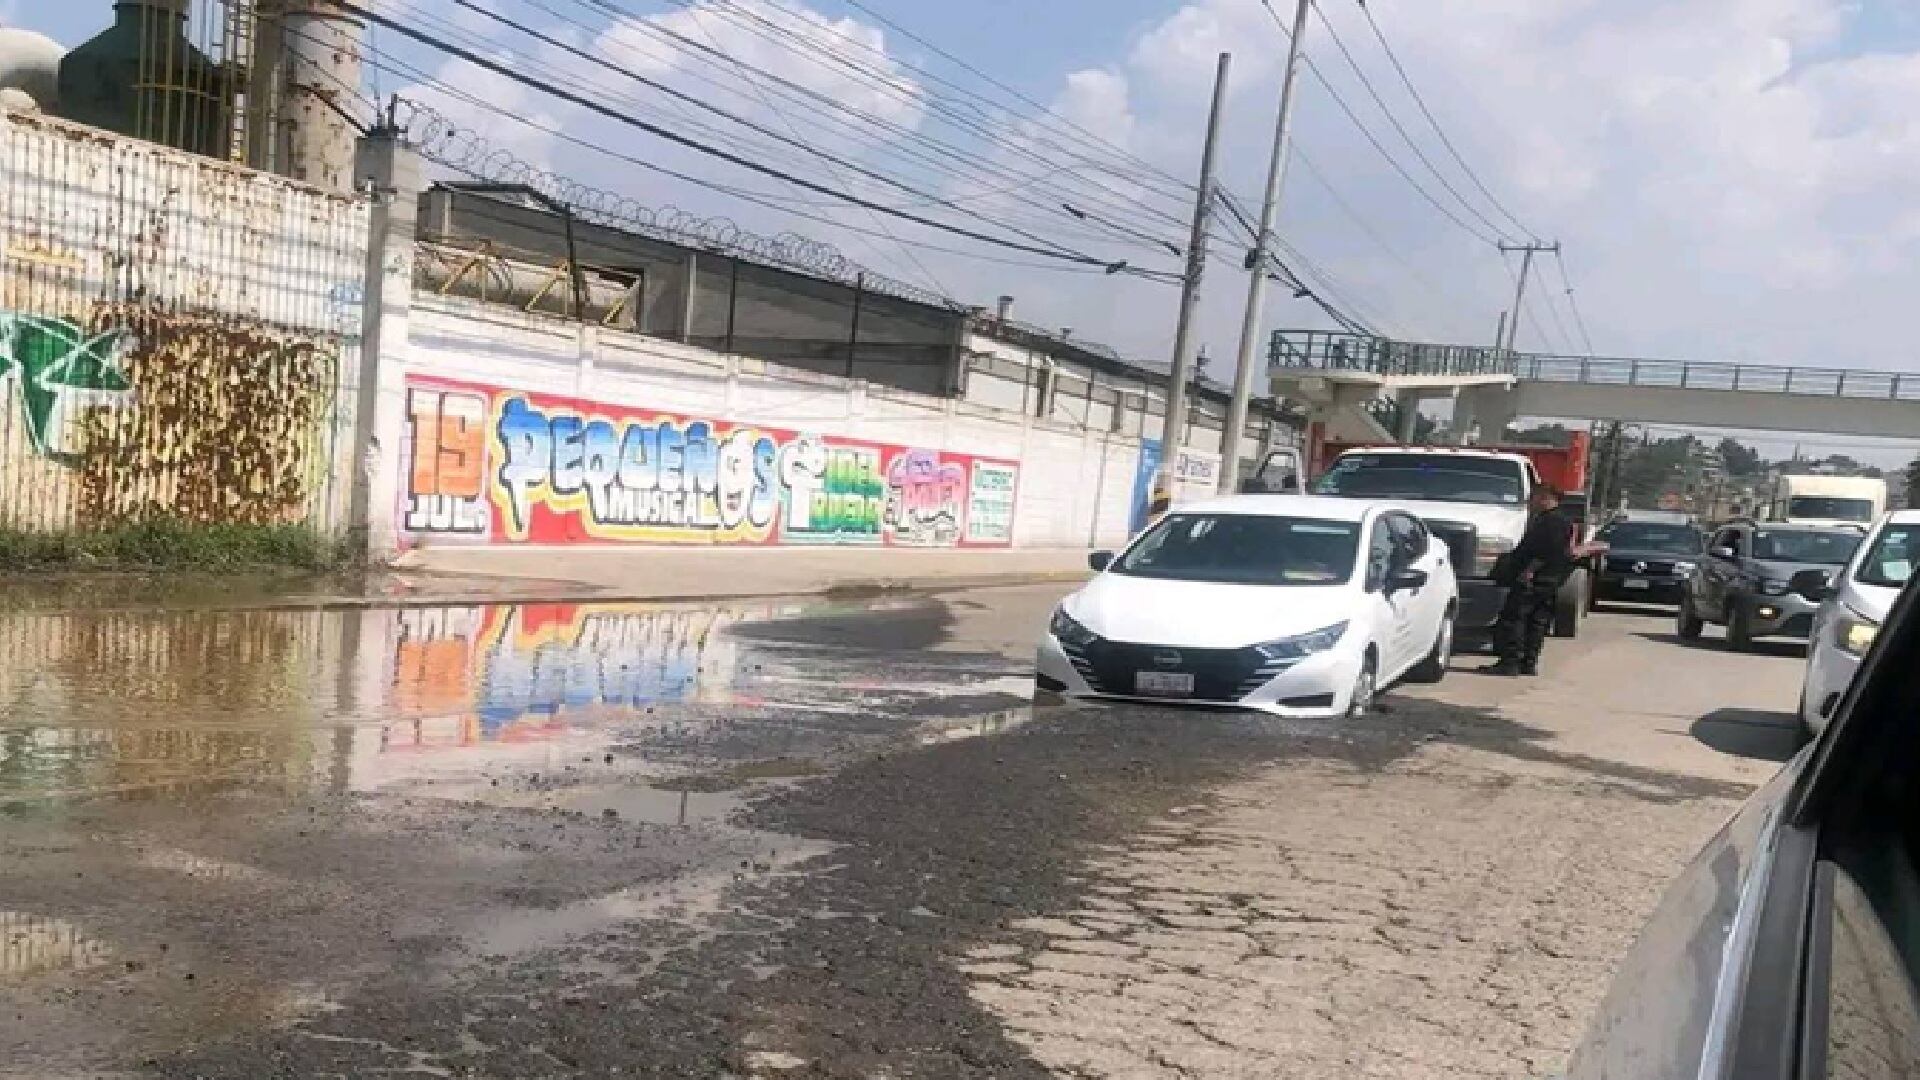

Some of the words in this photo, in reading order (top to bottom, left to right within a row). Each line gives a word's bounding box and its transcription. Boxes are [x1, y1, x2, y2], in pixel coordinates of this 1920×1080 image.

[407, 387, 484, 498] 19
[497, 397, 777, 532] PEQUEÑOS
[604, 486, 719, 526] MUSICAL
